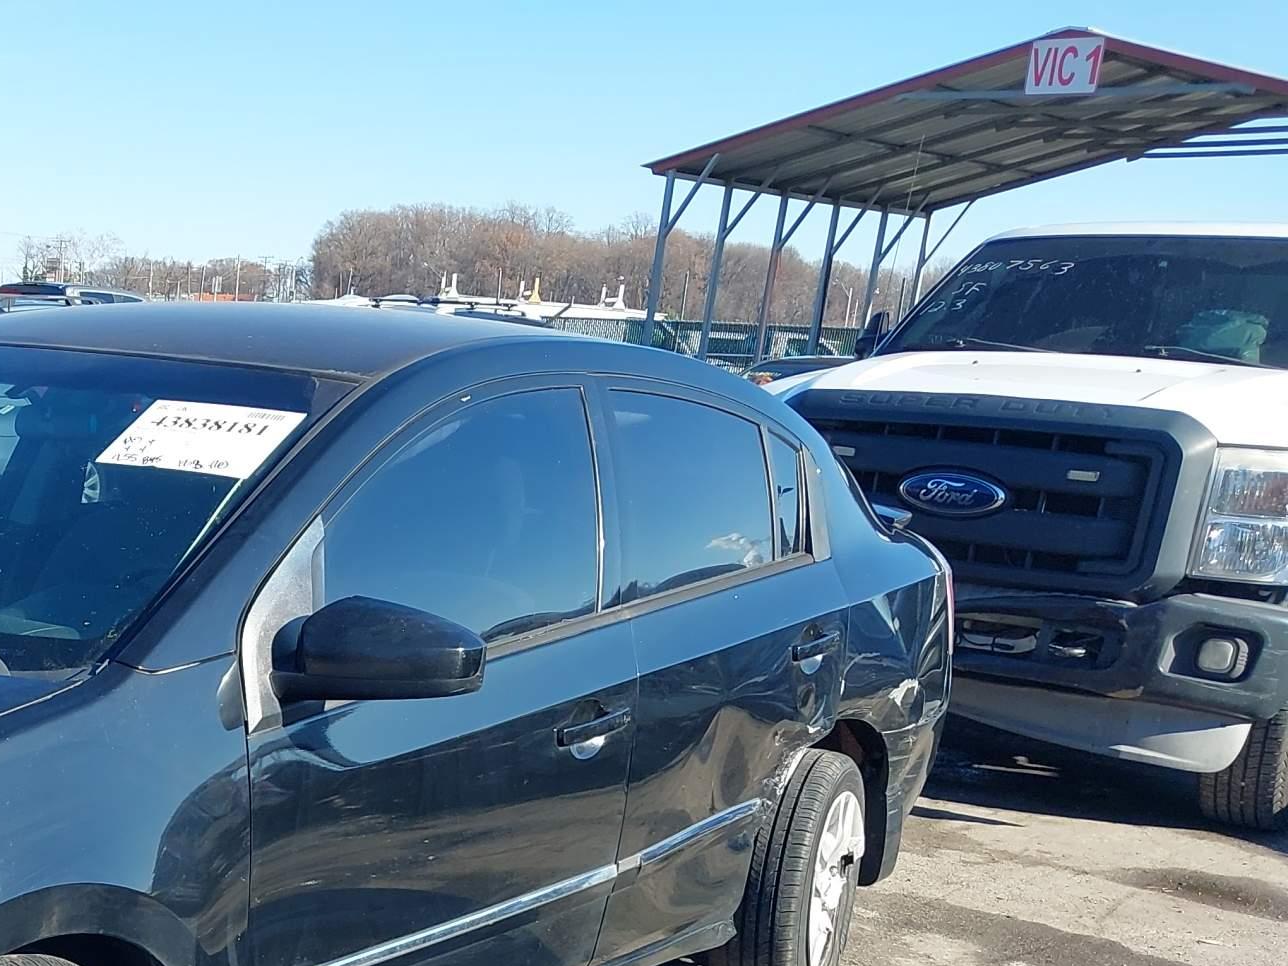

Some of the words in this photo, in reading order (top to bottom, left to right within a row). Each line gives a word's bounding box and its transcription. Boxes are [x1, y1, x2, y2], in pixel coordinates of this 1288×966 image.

[1033, 46, 1079, 87] VIC
[1085, 44, 1102, 85] 1
[151, 415, 270, 436] 43838181
[918, 478, 978, 506] Ford
